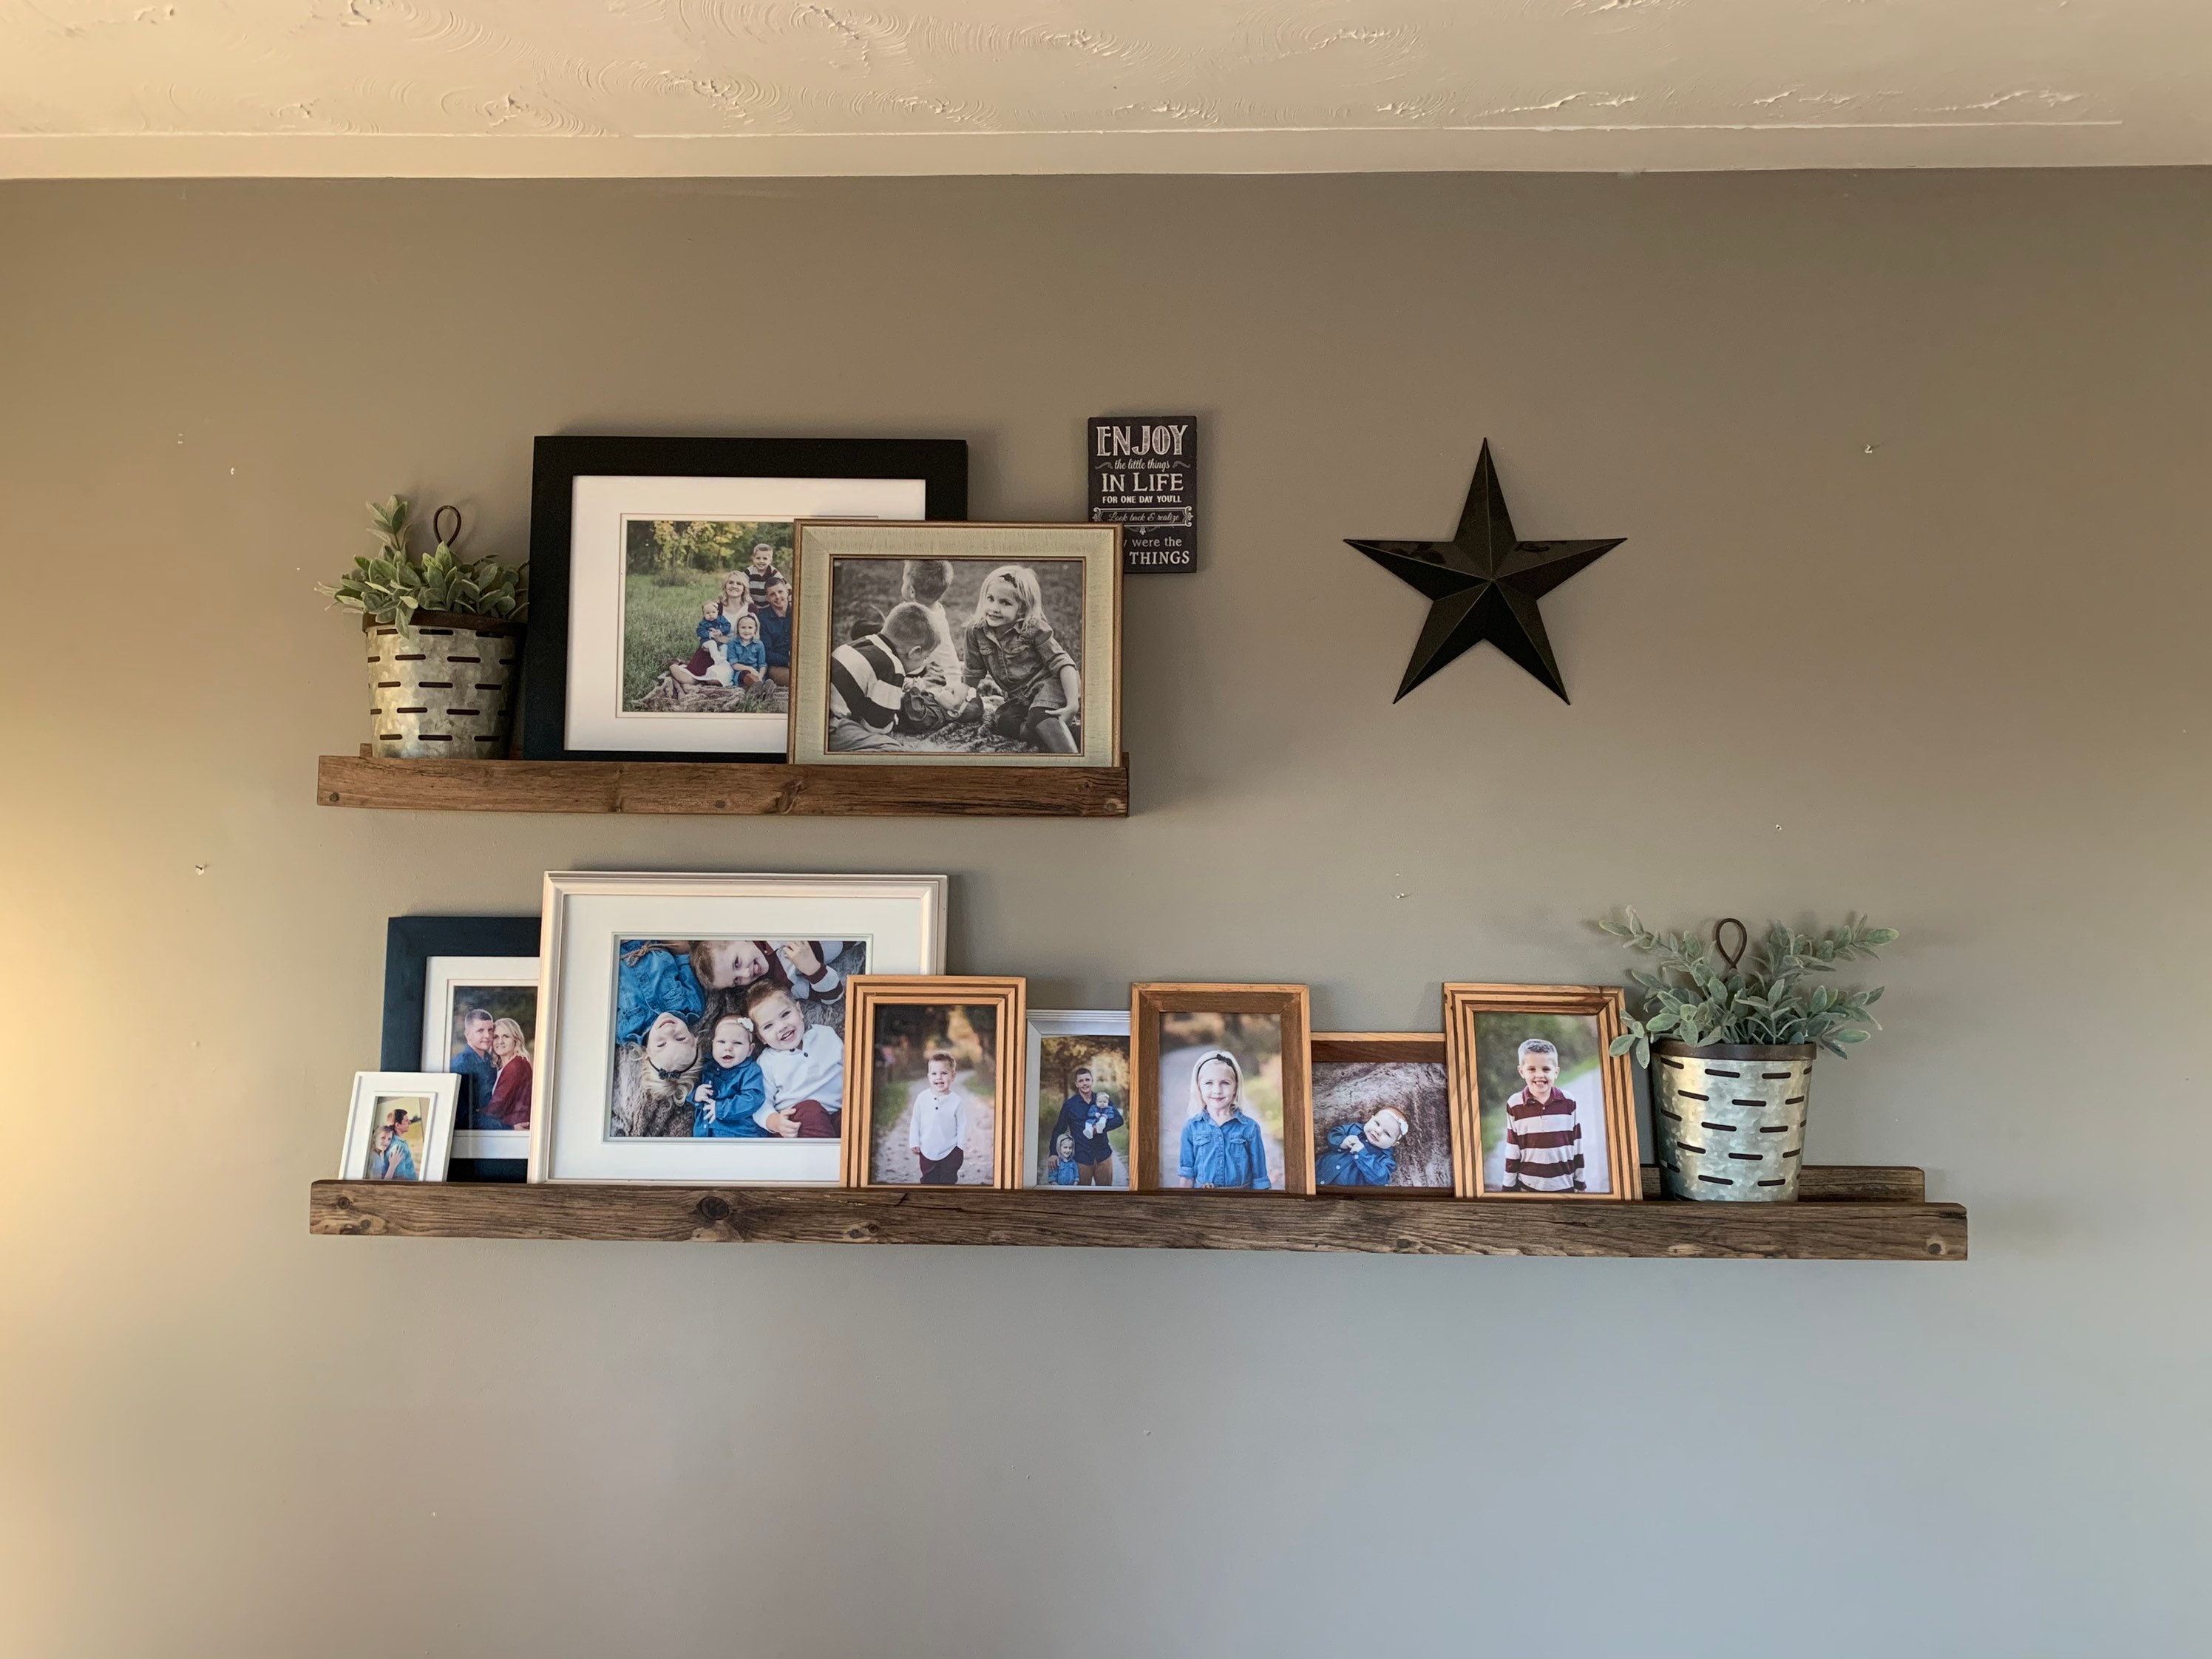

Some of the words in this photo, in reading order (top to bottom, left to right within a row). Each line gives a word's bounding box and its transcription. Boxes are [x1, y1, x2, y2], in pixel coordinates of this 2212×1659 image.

[1096, 425, 1188, 456] ENJOY
[1114, 458, 1127, 469] the
[1127, 458, 1146, 469] little
[1147, 458, 1170, 472] things
[1102, 473, 1124, 492] IN
[1133, 472, 1184, 492] LIFE
[1139, 495, 1153, 503] DAY
[1108, 512, 1127, 521] Look
[1130, 512, 1145, 521] back
[1147, 512, 1156, 520] &
[1158, 512, 1180, 523] realize
[1132, 539, 1160, 547] were
[1165, 537, 1181, 546] the
[1130, 551, 1190, 565] THINGS
